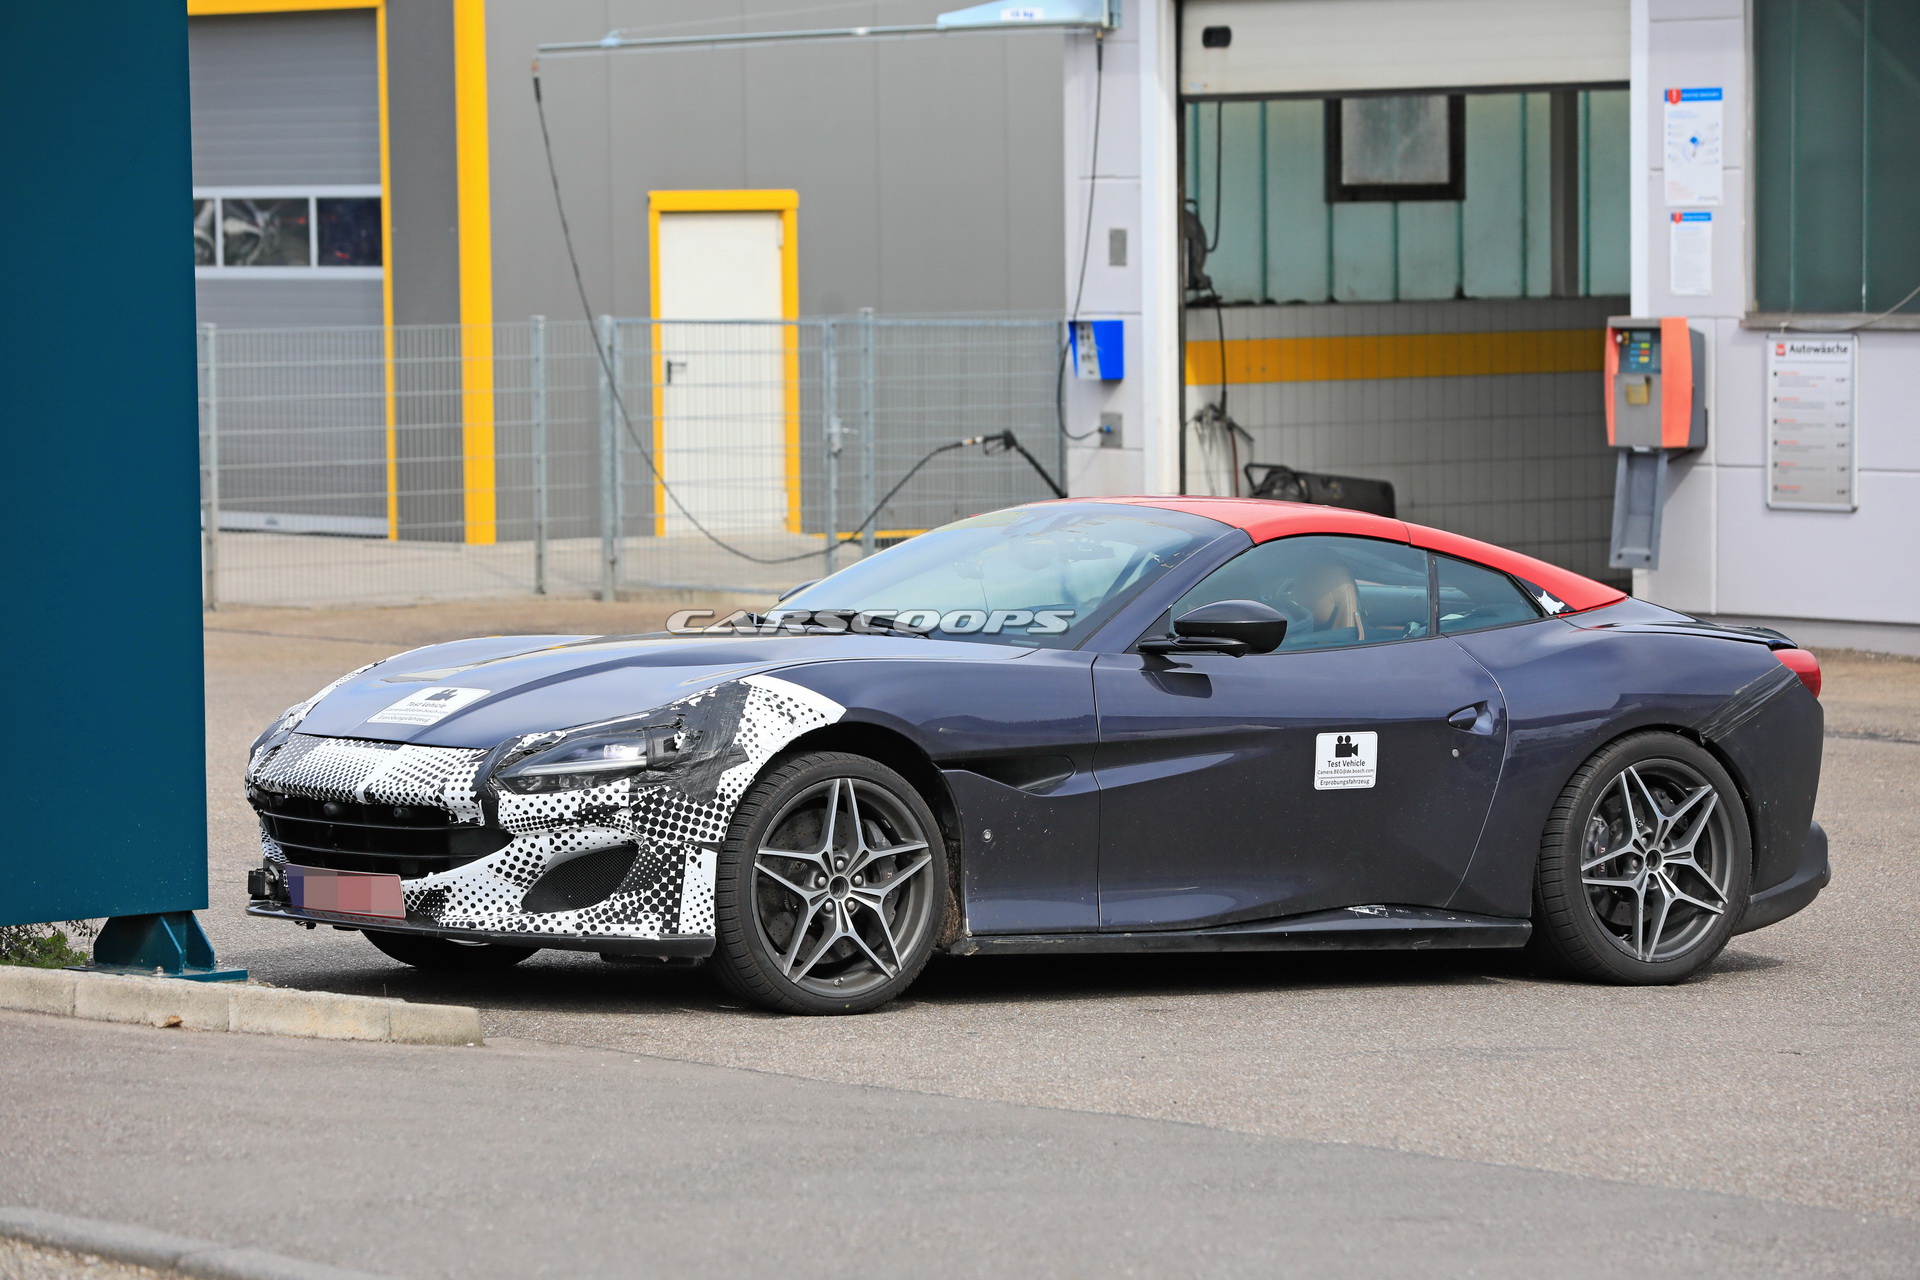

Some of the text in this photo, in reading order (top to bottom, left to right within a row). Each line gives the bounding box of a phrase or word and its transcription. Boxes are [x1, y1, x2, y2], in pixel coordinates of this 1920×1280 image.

[1789, 343, 1849, 354] Autowäsche
[1327, 759, 1366, 768] Test Vehicle
